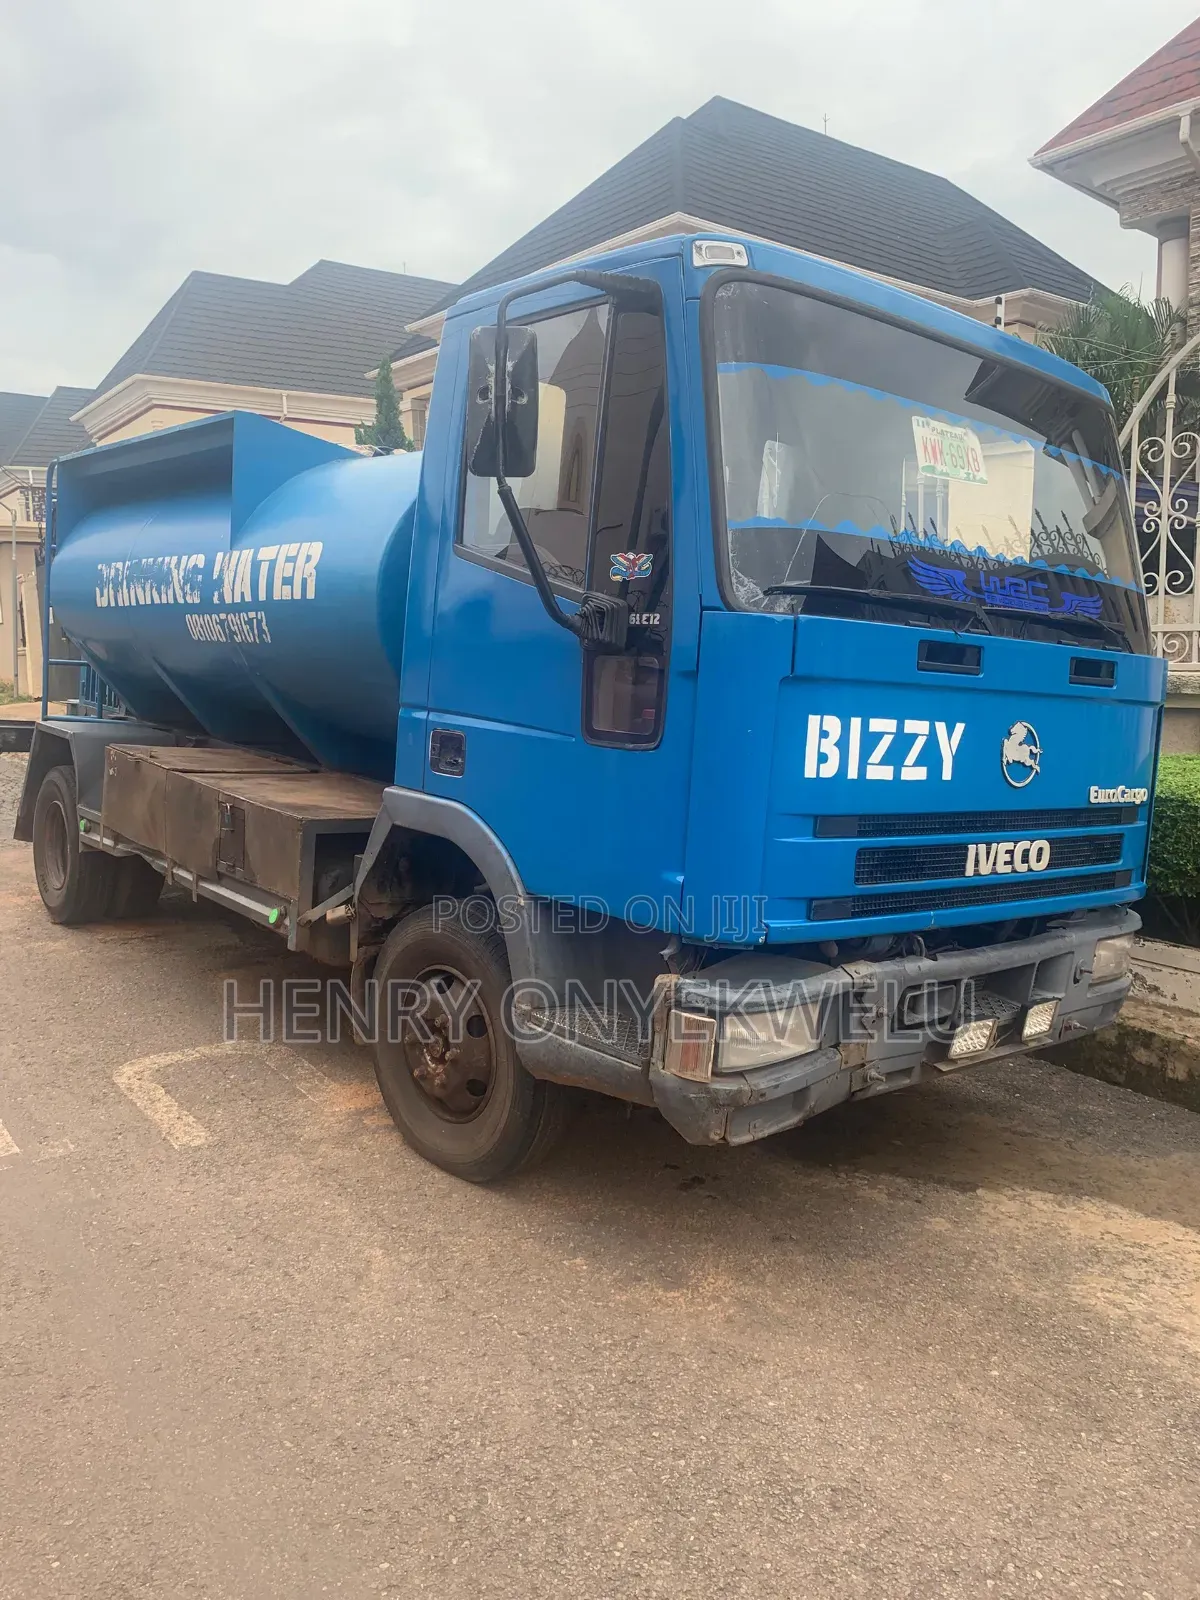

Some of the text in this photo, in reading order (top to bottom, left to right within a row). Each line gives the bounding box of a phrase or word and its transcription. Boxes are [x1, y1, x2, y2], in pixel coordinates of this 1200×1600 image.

[931, 427, 965, 441] PLATEAU
[213, 542, 323, 604] WATER
[804, 714, 966, 781] BIZZY
[1089, 785, 1148, 804] EuroCargo
[965, 839, 1050, 877] IVECO
